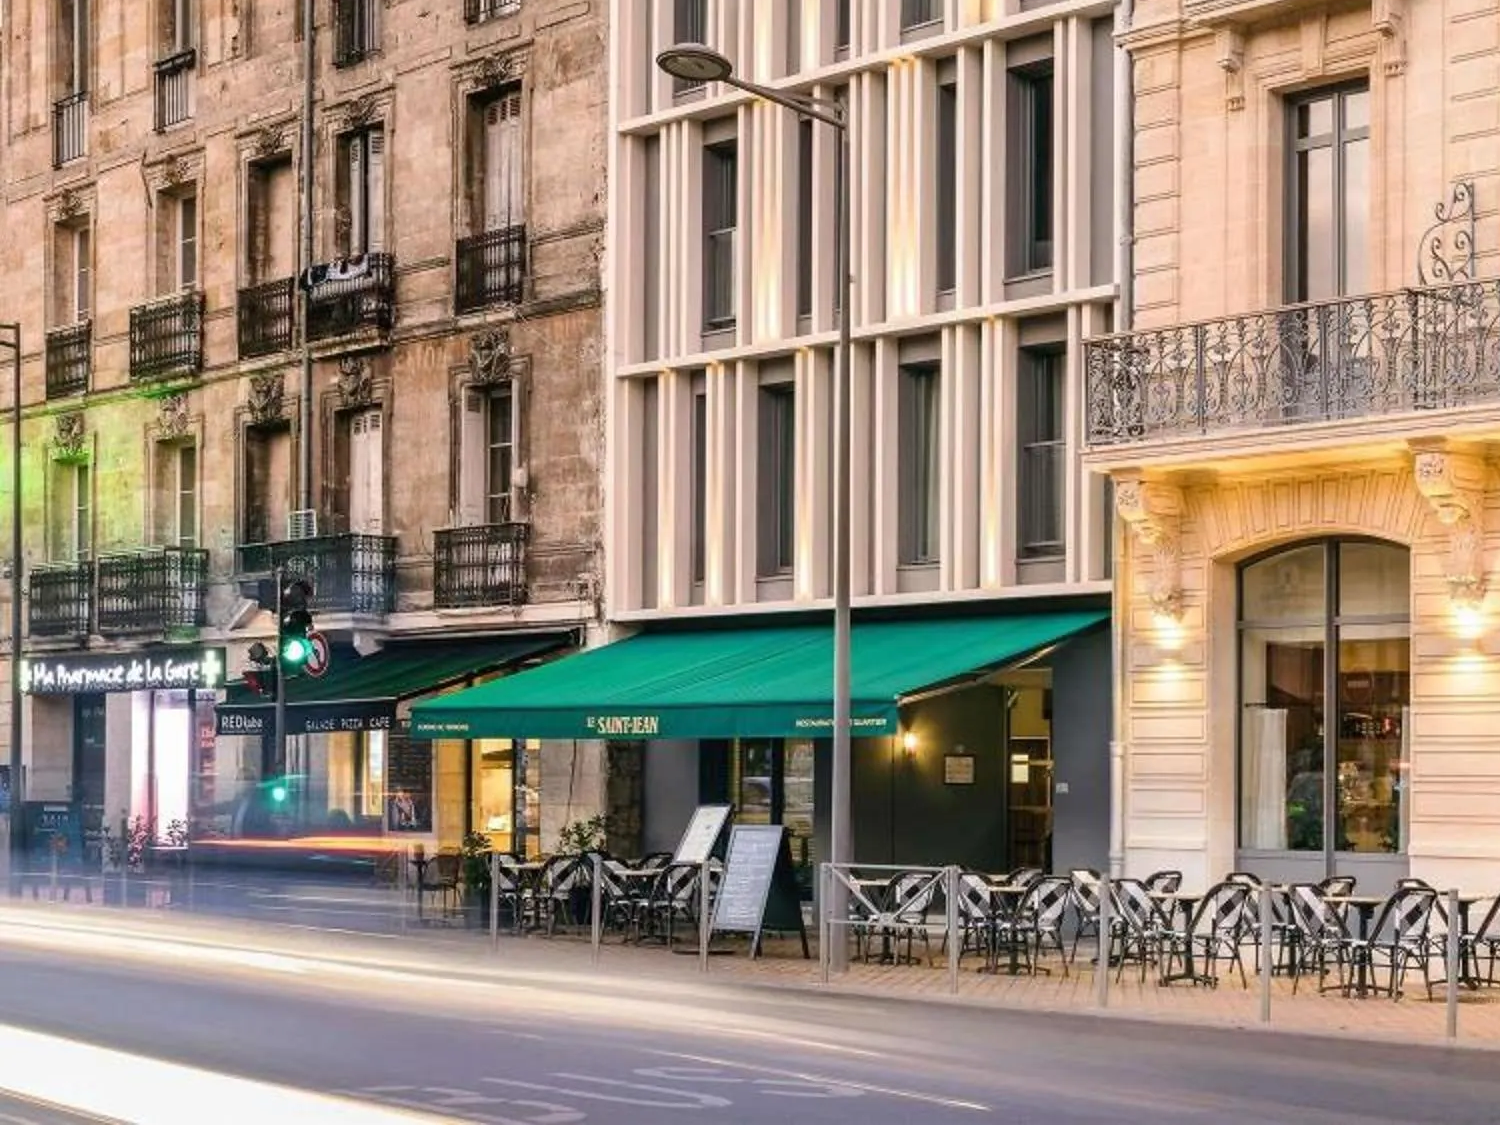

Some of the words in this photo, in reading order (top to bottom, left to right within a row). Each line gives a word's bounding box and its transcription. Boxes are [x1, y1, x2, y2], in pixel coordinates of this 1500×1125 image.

[33, 662, 55, 685] Ma
[56, 664, 125, 685] Pharmacie
[126, 660, 144, 683] de
[164, 658, 199, 681] Gare
[341, 718, 364, 730] PIZZA
[597, 716, 659, 734] SAINT-JEAN
[333, 1066, 864, 1125] BUS
